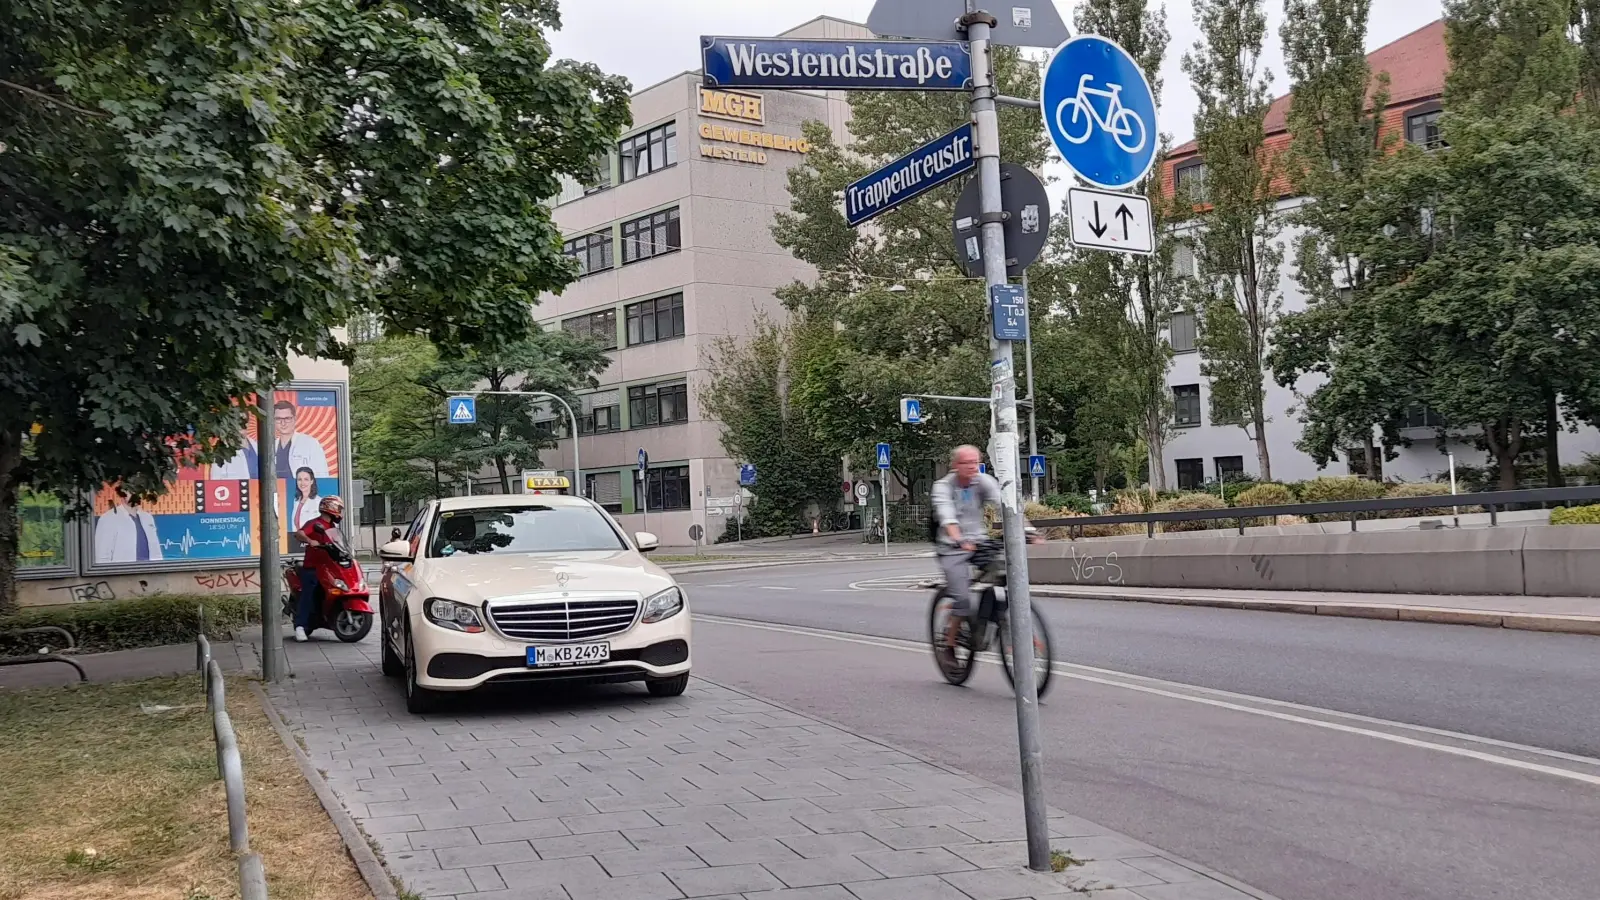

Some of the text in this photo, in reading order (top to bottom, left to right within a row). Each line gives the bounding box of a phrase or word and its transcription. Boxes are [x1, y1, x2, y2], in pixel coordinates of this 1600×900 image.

[726, 43, 953, 84] Westendstraße
[700, 88, 762, 120] MGH
[698, 122, 809, 154] GEWERBEHO
[699, 143, 768, 164] WESTEND
[848, 134, 972, 215] Trappentreustr.
[1012, 296, 1024, 304] 150
[534, 477, 563, 487] TAXI
[200, 516, 246, 524] DONNERSTAGS
[536, 644, 608, 662] M KB 2493
